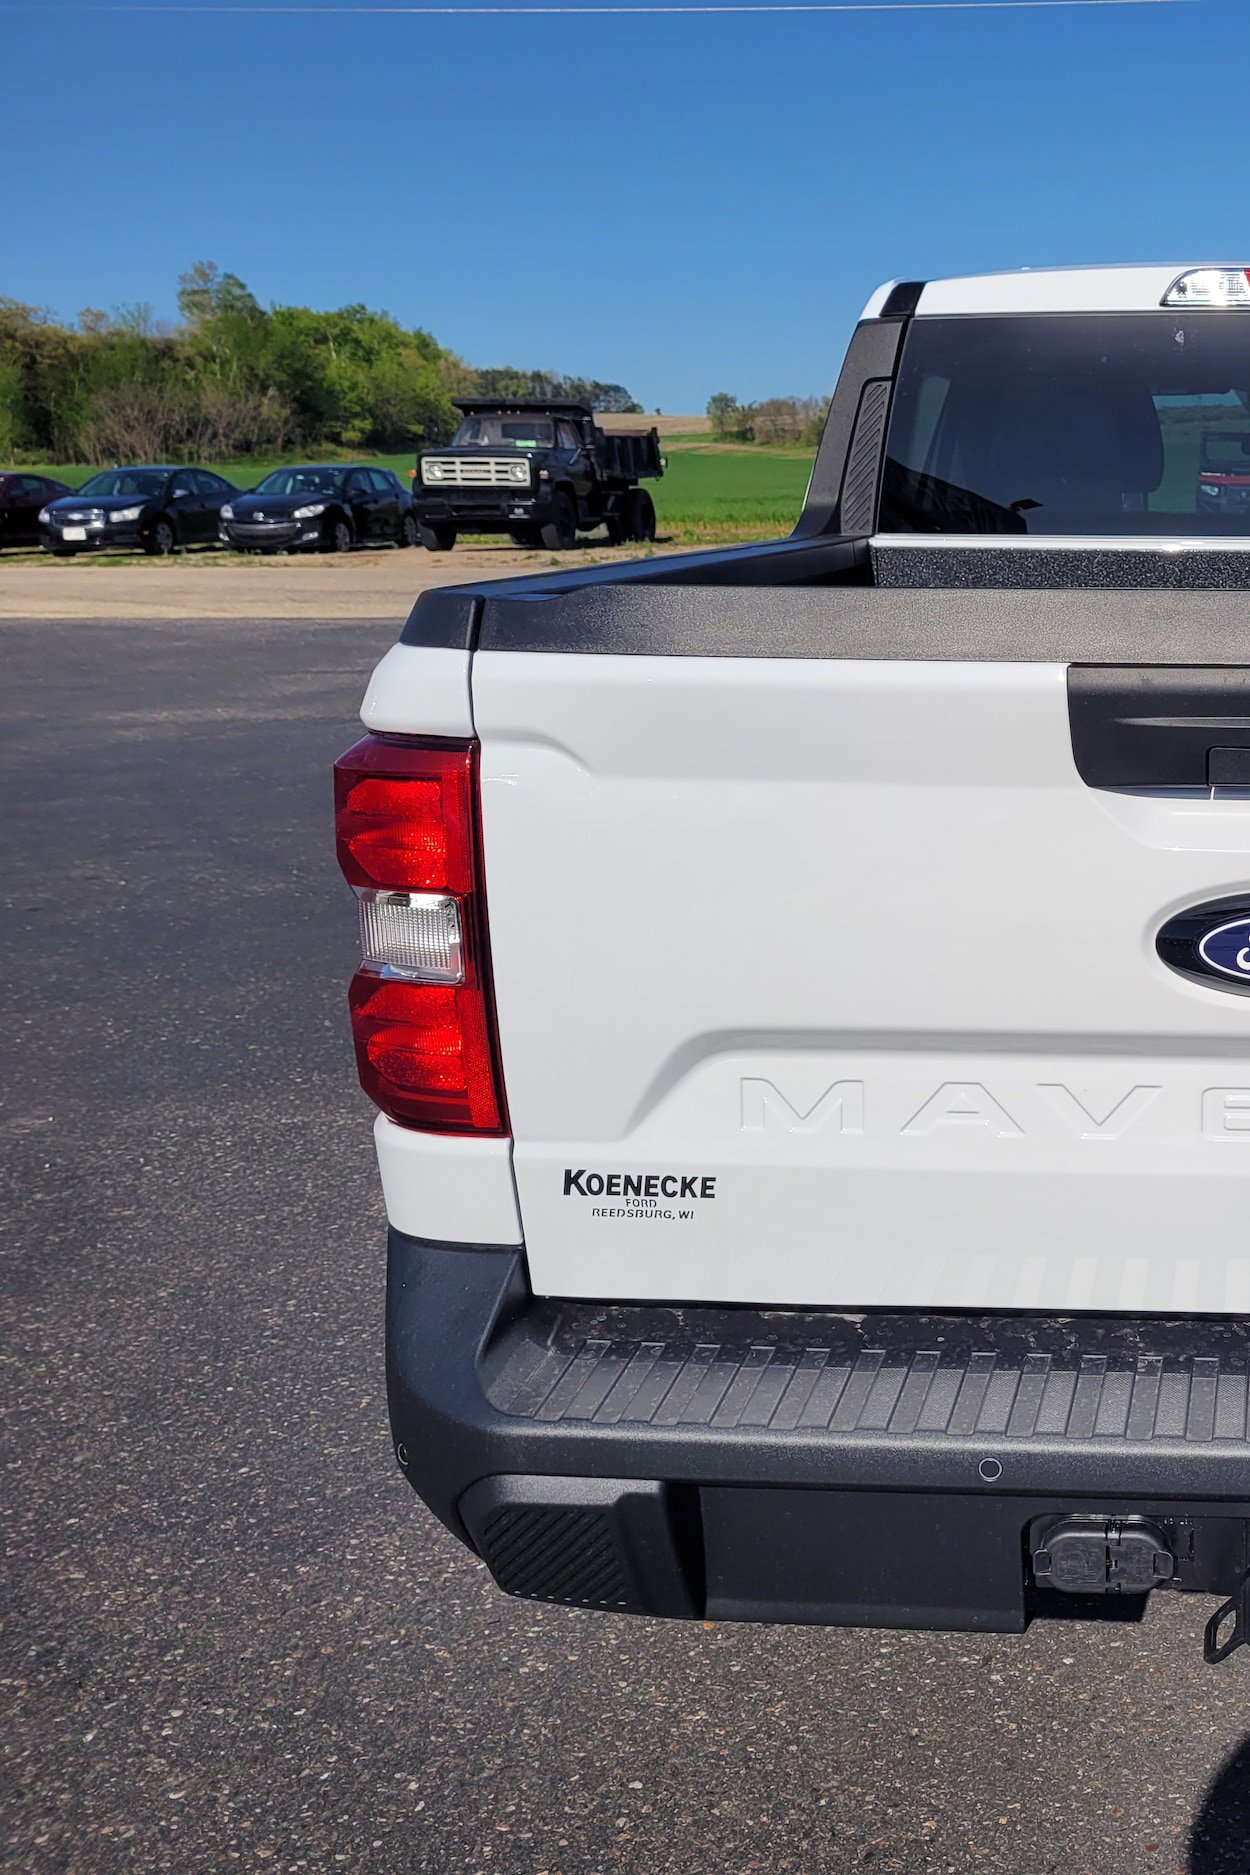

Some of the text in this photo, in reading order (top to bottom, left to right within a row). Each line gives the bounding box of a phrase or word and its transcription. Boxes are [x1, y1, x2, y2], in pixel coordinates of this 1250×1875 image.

[563, 1169, 717, 1199] KOENECKE
[625, 1198, 657, 1208] FORD
[592, 1208, 694, 1220] REEDSBURG, WI
